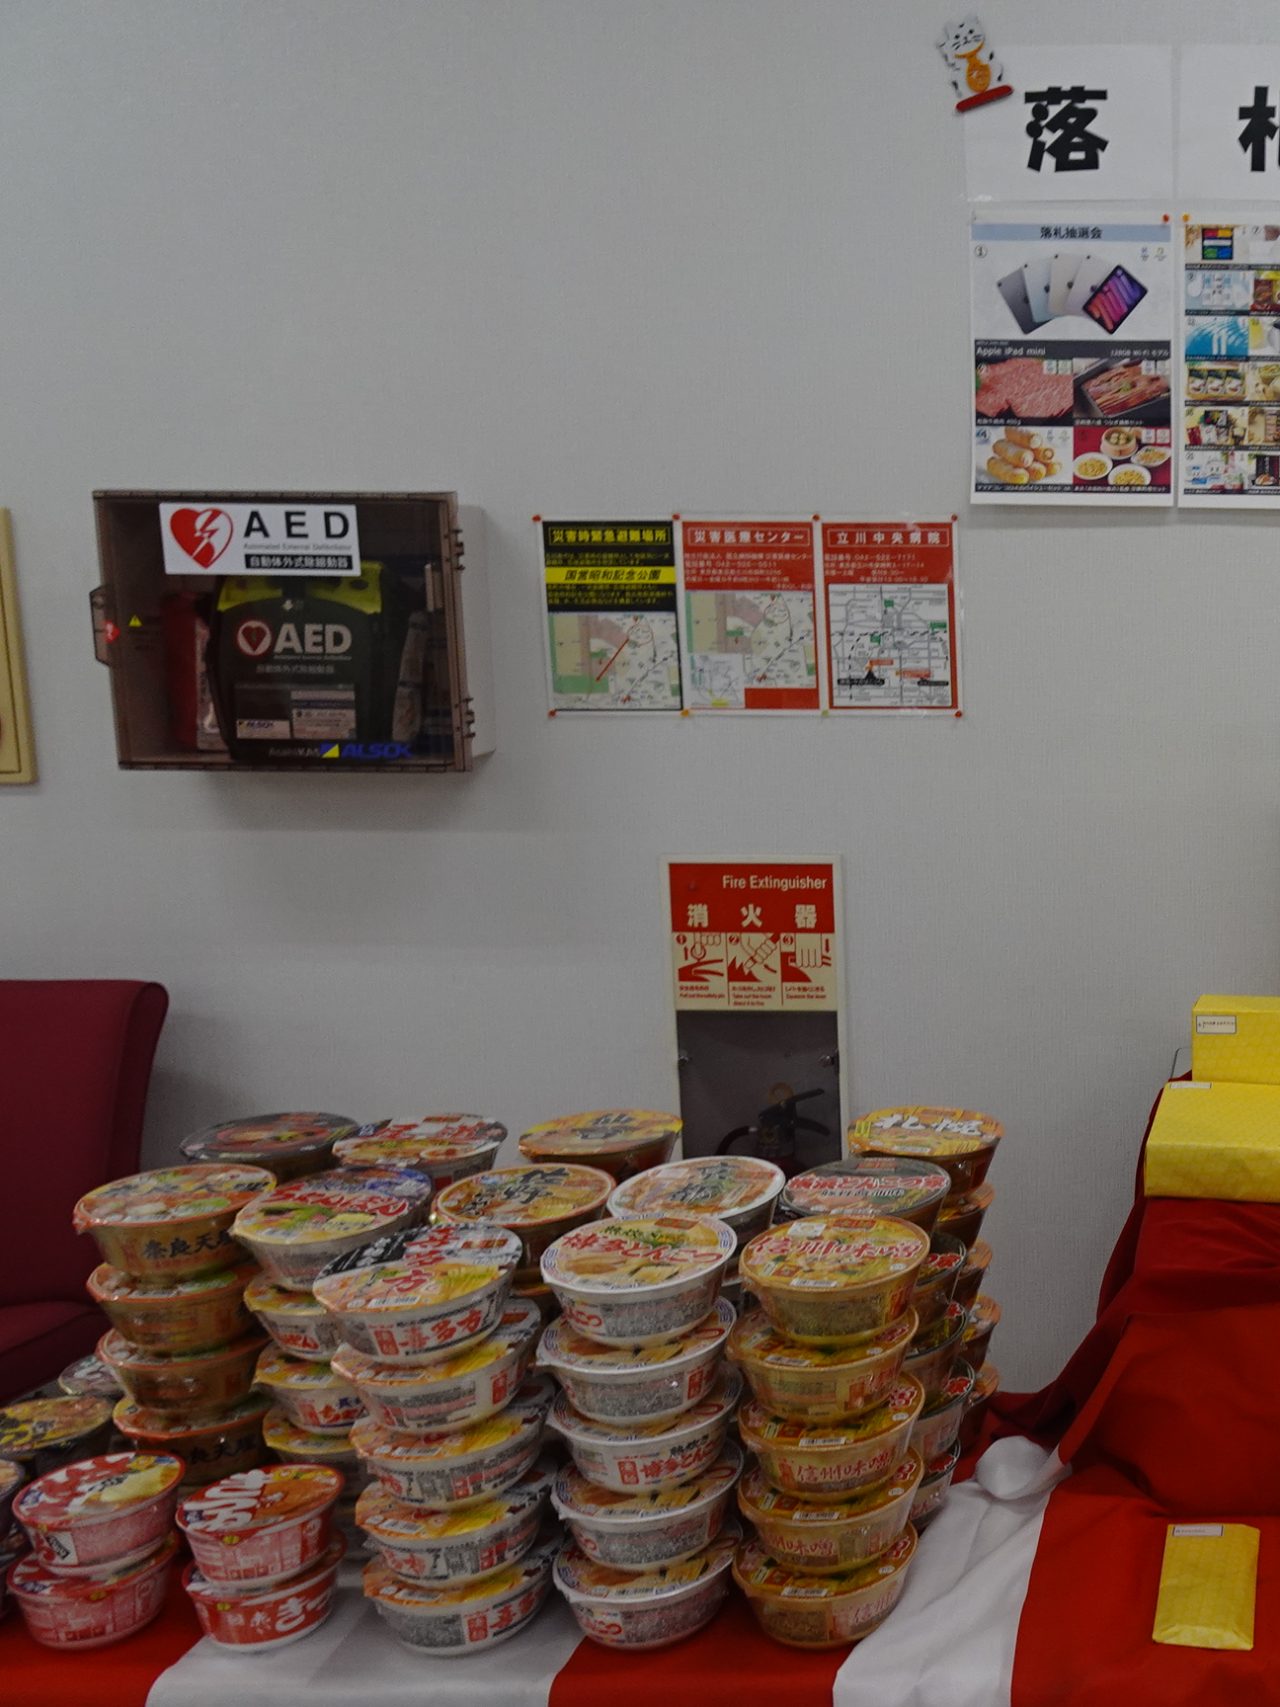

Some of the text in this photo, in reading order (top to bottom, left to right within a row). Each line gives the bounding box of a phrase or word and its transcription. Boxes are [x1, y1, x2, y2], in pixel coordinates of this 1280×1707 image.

[1040, 227, 1103, 239] 落札抽選会
[976, 346, 1046, 356] Apple iPad mini
[244, 510, 350, 539] AED
[694, 530, 804, 543] 災害医療センター
[837, 531, 940, 545] 立川中央病院
[249, 555, 348, 568] 自動体外式除細動器
[564, 569, 661, 581] 国営昭和記念公園
[273, 623, 352, 655] AED
[340, 743, 412, 759] ALSOK
[722, 875, 827, 891] Fire Extinguisher
[687, 903, 817, 929] 消火器
[873, 1113, 983, 1136] 札幌
